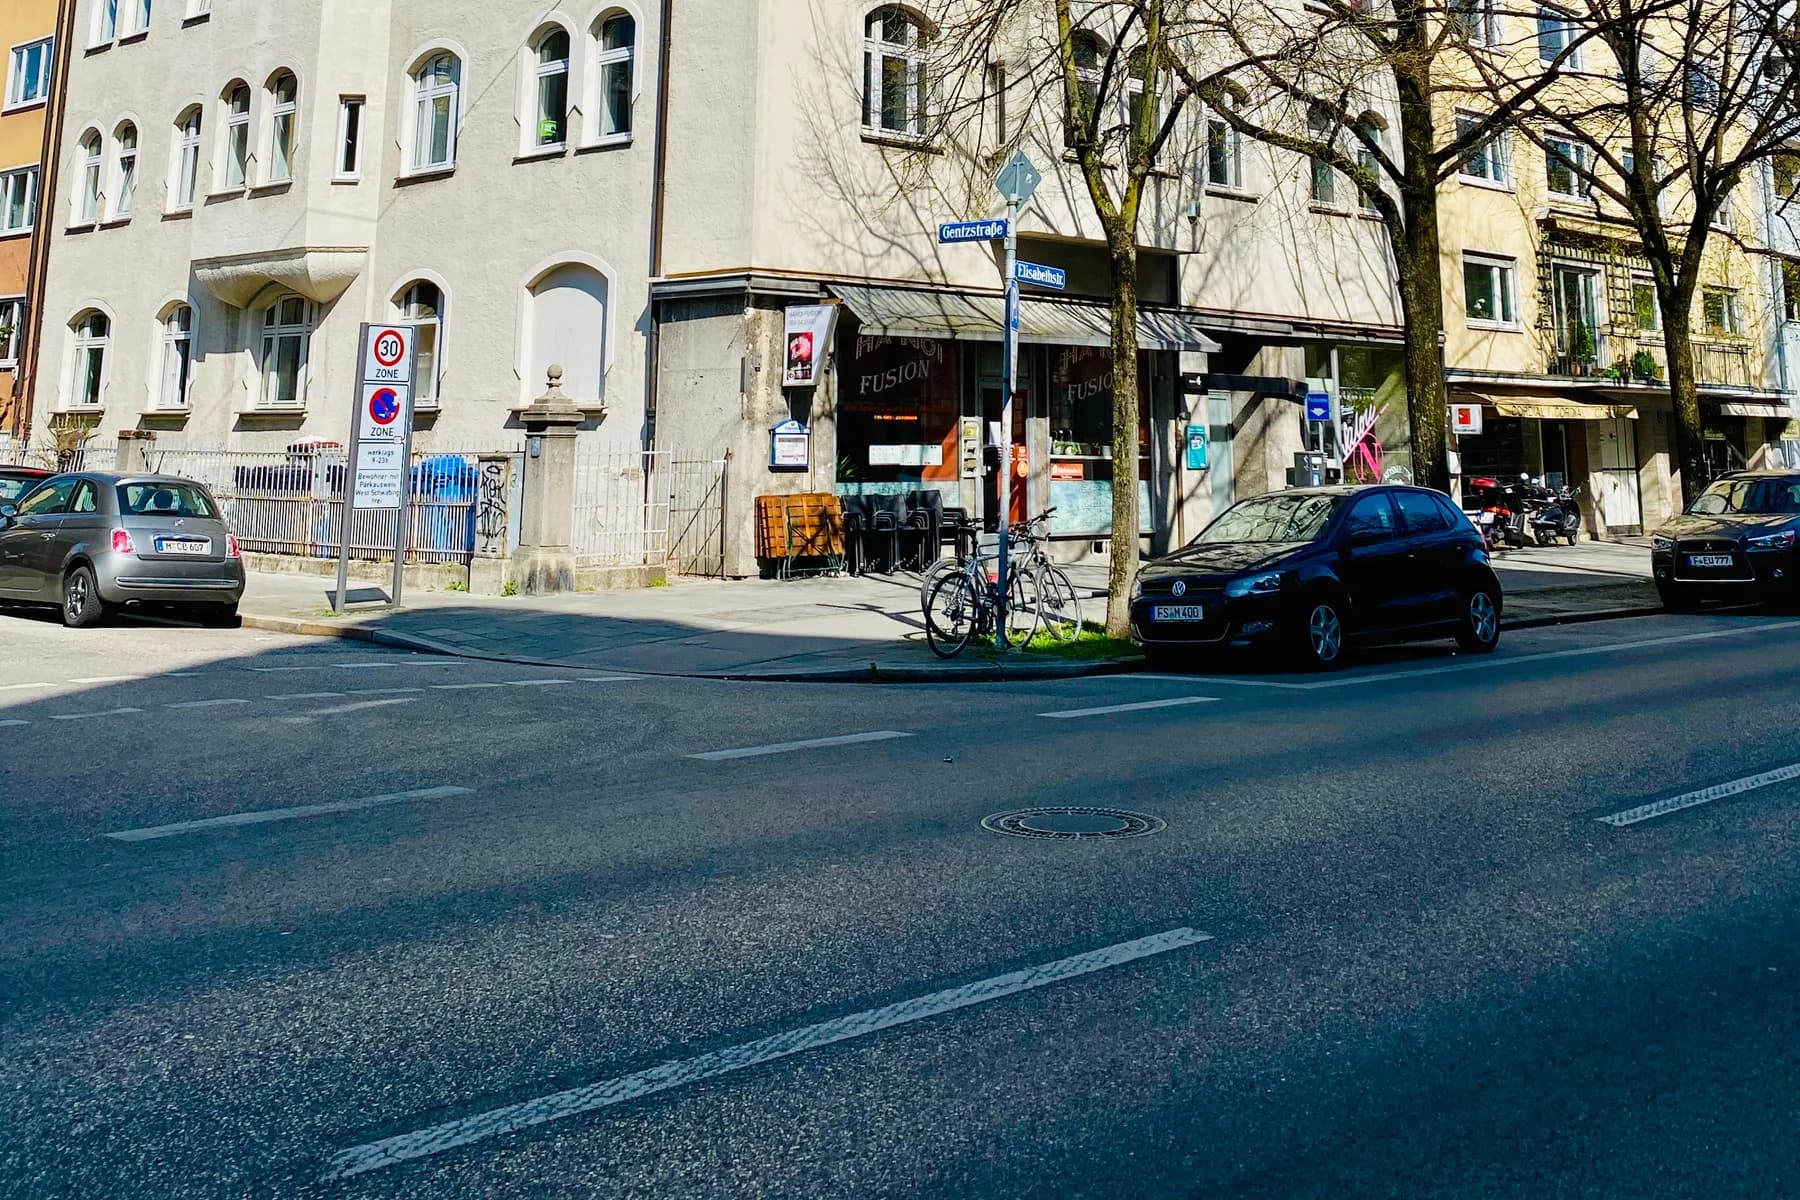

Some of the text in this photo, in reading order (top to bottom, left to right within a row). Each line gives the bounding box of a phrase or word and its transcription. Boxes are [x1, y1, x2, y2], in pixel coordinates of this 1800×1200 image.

[942, 221, 1003, 239] Gentzstraße
[1017, 263, 1064, 286] Elisabethstr.
[380, 339, 398, 357] 30
[375, 368, 399, 379] ZONE
[859, 359, 930, 395] FUSION
[1067, 371, 1113, 402] FUSIO
[370, 427, 394, 437] ZONE
[1157, 607, 1169, 618] FS
[1182, 606, 1199, 618] 400
